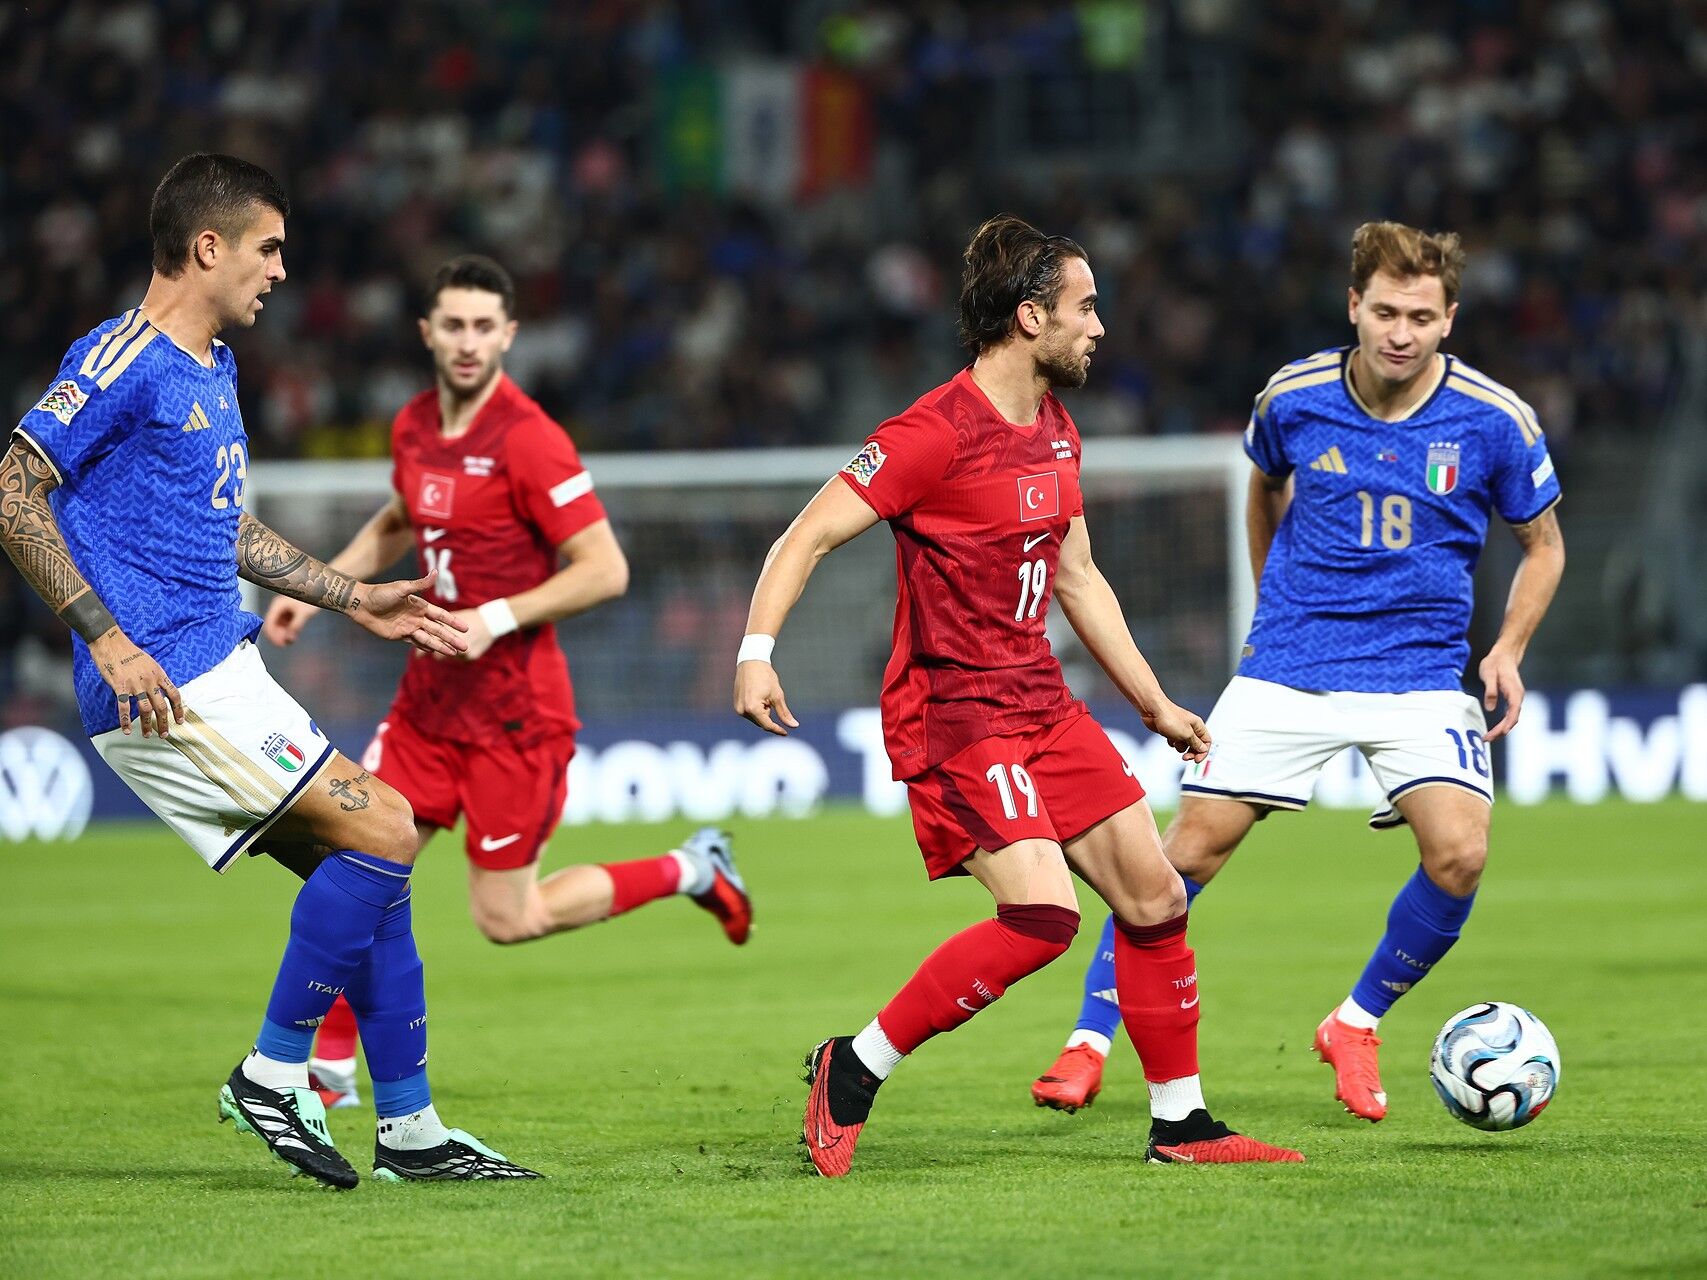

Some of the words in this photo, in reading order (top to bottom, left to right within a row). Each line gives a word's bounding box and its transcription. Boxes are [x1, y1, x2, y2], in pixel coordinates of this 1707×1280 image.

[211, 442, 247, 510] 23
[1357, 490, 1412, 551] 18
[1015, 558, 1047, 622] 19
[268, 738, 286, 758] ITALIA
[1445, 728, 1489, 778] 18
[985, 763, 1038, 820] 19
[1396, 949, 1431, 970] ITALI
[307, 980, 345, 995] ITALI
[1171, 967, 1196, 990] TÜRK
[409, 1010, 428, 1030] ITA
